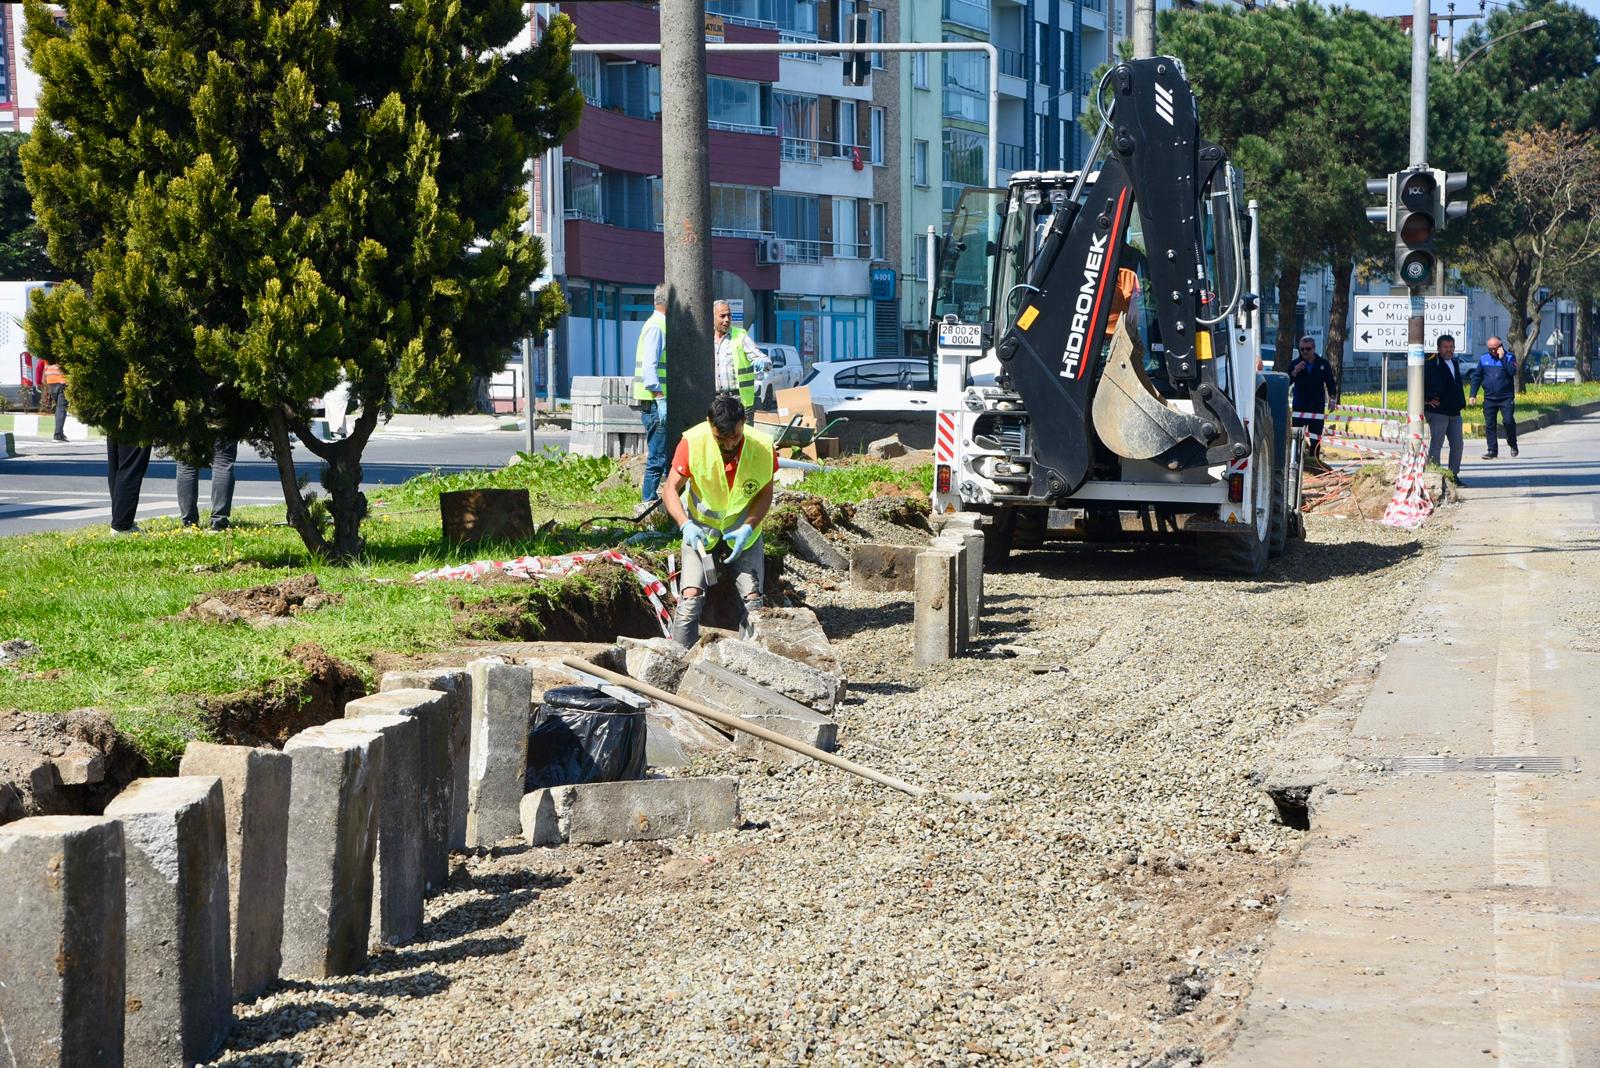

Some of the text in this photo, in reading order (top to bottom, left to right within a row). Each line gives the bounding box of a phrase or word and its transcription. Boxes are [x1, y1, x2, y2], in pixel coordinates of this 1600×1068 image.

[1379, 302, 1409, 310] Orma
[942, 326, 980, 335] 28 00 26
[952, 336, 974, 344] 0004
